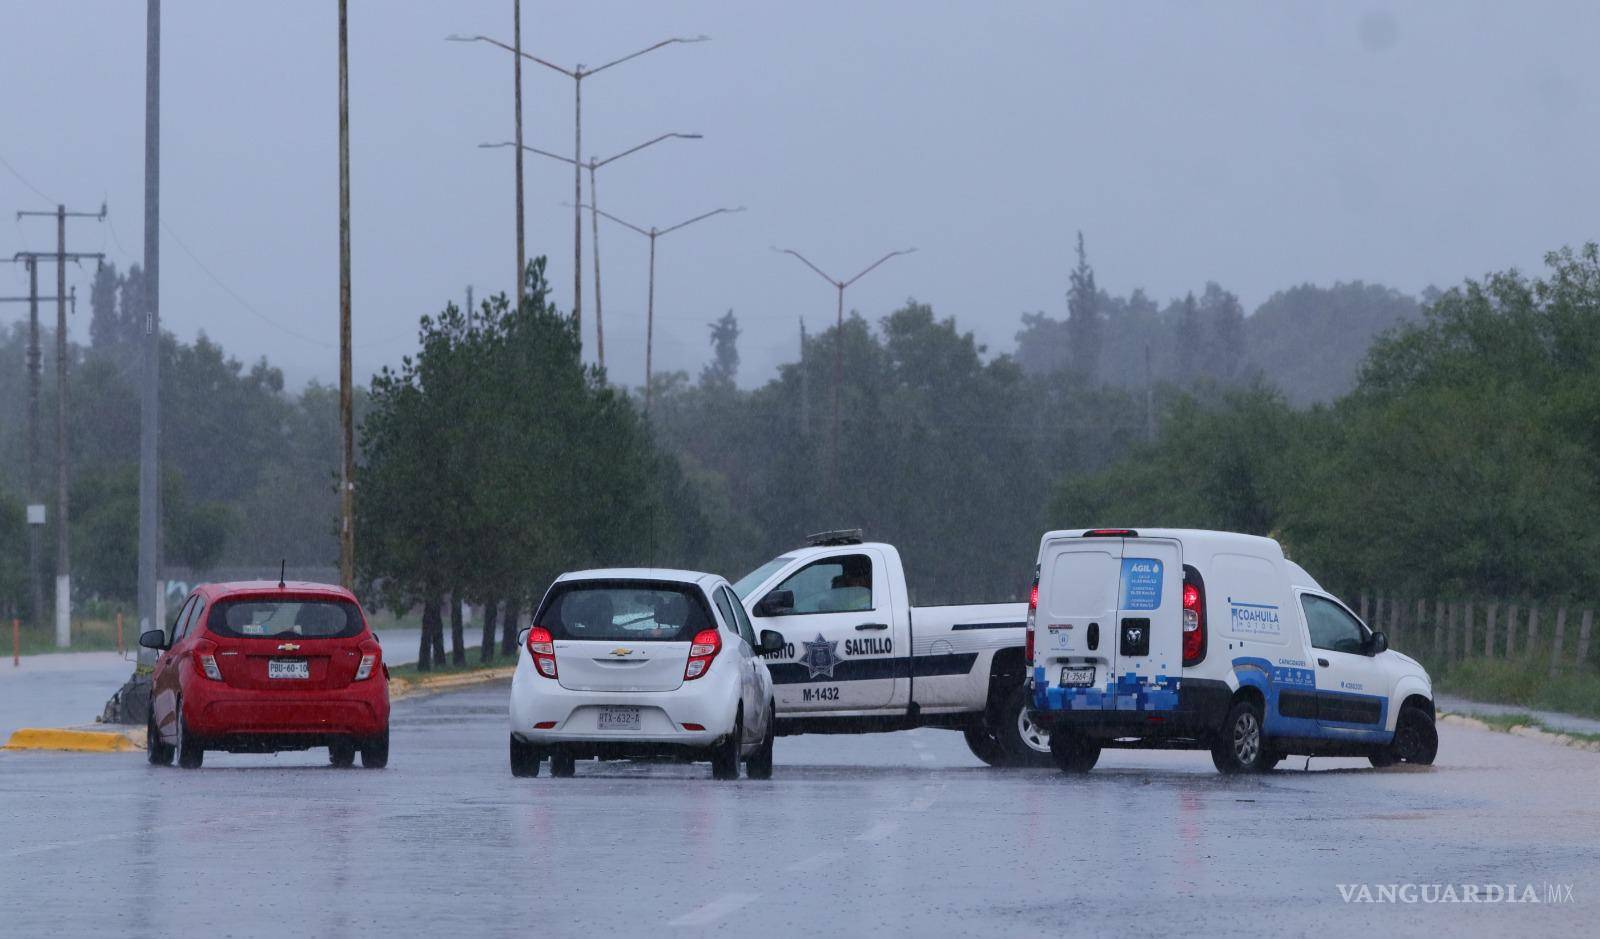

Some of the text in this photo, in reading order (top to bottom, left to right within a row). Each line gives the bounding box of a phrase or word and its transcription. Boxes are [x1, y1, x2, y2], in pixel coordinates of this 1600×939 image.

[1238, 608, 1280, 623] COAHUILA
[845, 637, 892, 656] SALTILLO
[803, 687, 839, 701] M-1432
